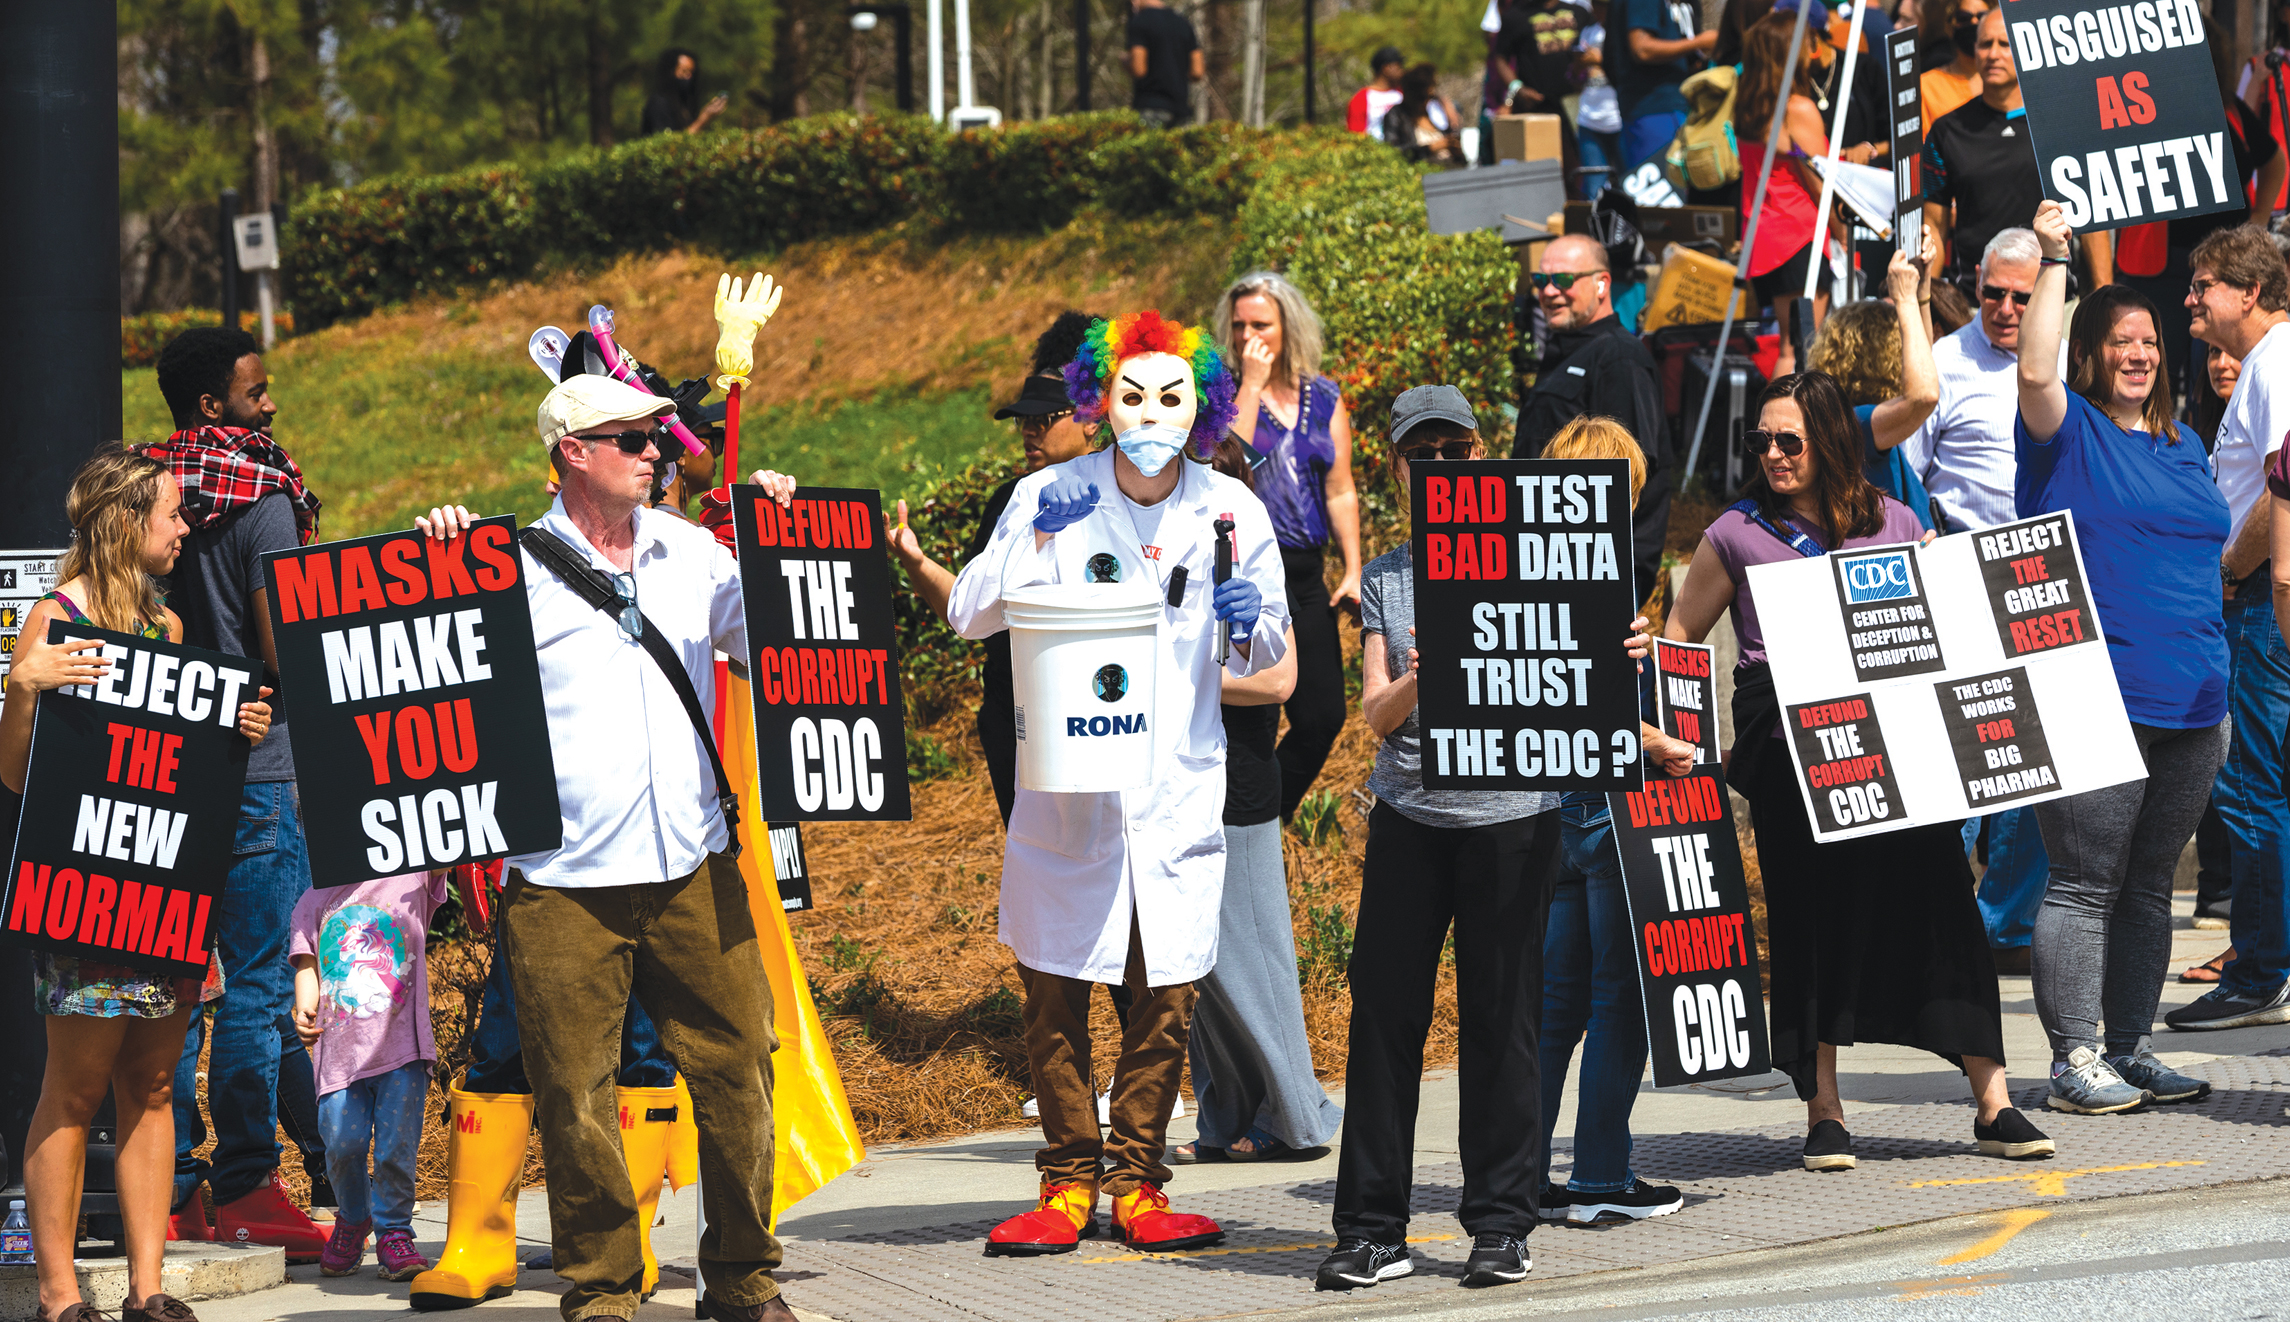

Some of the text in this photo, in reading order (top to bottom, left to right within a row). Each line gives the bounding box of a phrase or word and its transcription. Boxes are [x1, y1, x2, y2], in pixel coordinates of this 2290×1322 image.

[2011, 0, 2205, 72] DISGUISED
[2096, 71, 2157, 131] AS
[2051, 132, 2229, 228] SAFETY
[754, 498, 873, 550] DEFUND
[1426, 475, 1613, 524] BAD TEST
[1427, 533, 1620, 581] BAD DATA
[1980, 521, 2064, 561] REJECT
[273, 525, 518, 624] MASKS
[1849, 560, 1906, 589] CDC
[2010, 554, 2050, 585] THE
[780, 559, 860, 641] THE
[1852, 604, 1927, 629] CENTER FOR
[2004, 579, 2070, 615] GREAT
[1472, 602, 1579, 651] STILL
[1852, 626, 1933, 649] DECEPTION &
[2009, 608, 2084, 654] RESET
[322, 608, 492, 704] MAKE
[760, 646, 888, 706] CORRUPT
[1658, 644, 1710, 678] MASKS
[1856, 644, 1939, 669] CORRUPTION
[1460, 657, 1593, 707] TRUST
[1667, 676, 1703, 711] MAKE
[1953, 676, 2014, 702] THE CDC
[1066, 713, 1147, 737] RONA
[1674, 710, 1701, 744] YOU
[1798, 699, 1868, 729] DEFUND
[1961, 696, 2016, 720] WORKS
[1976, 719, 2016, 744] FOR
[107, 721, 184, 795] THE
[354, 697, 479, 786] YOU
[790, 716, 885, 813] CDC
[1430, 728, 1637, 778] THE CDC ?
[1815, 723, 1865, 761] THE
[1984, 744, 2023, 770] BIG
[1808, 753, 1885, 789] CORRUPT
[1968, 765, 2056, 800] PHARMA
[361, 780, 509, 873] SICK
[1626, 776, 1723, 829] DEFUND
[1829, 781, 1889, 827] CDC
[72, 794, 189, 870] NEW
[768, 826, 802, 881] MPLY
[1651, 833, 1721, 913] THE
[9, 860, 213, 966] NORMAL
[1644, 912, 1748, 977] CORRUPT
[1672, 978, 1750, 1075] CDC
